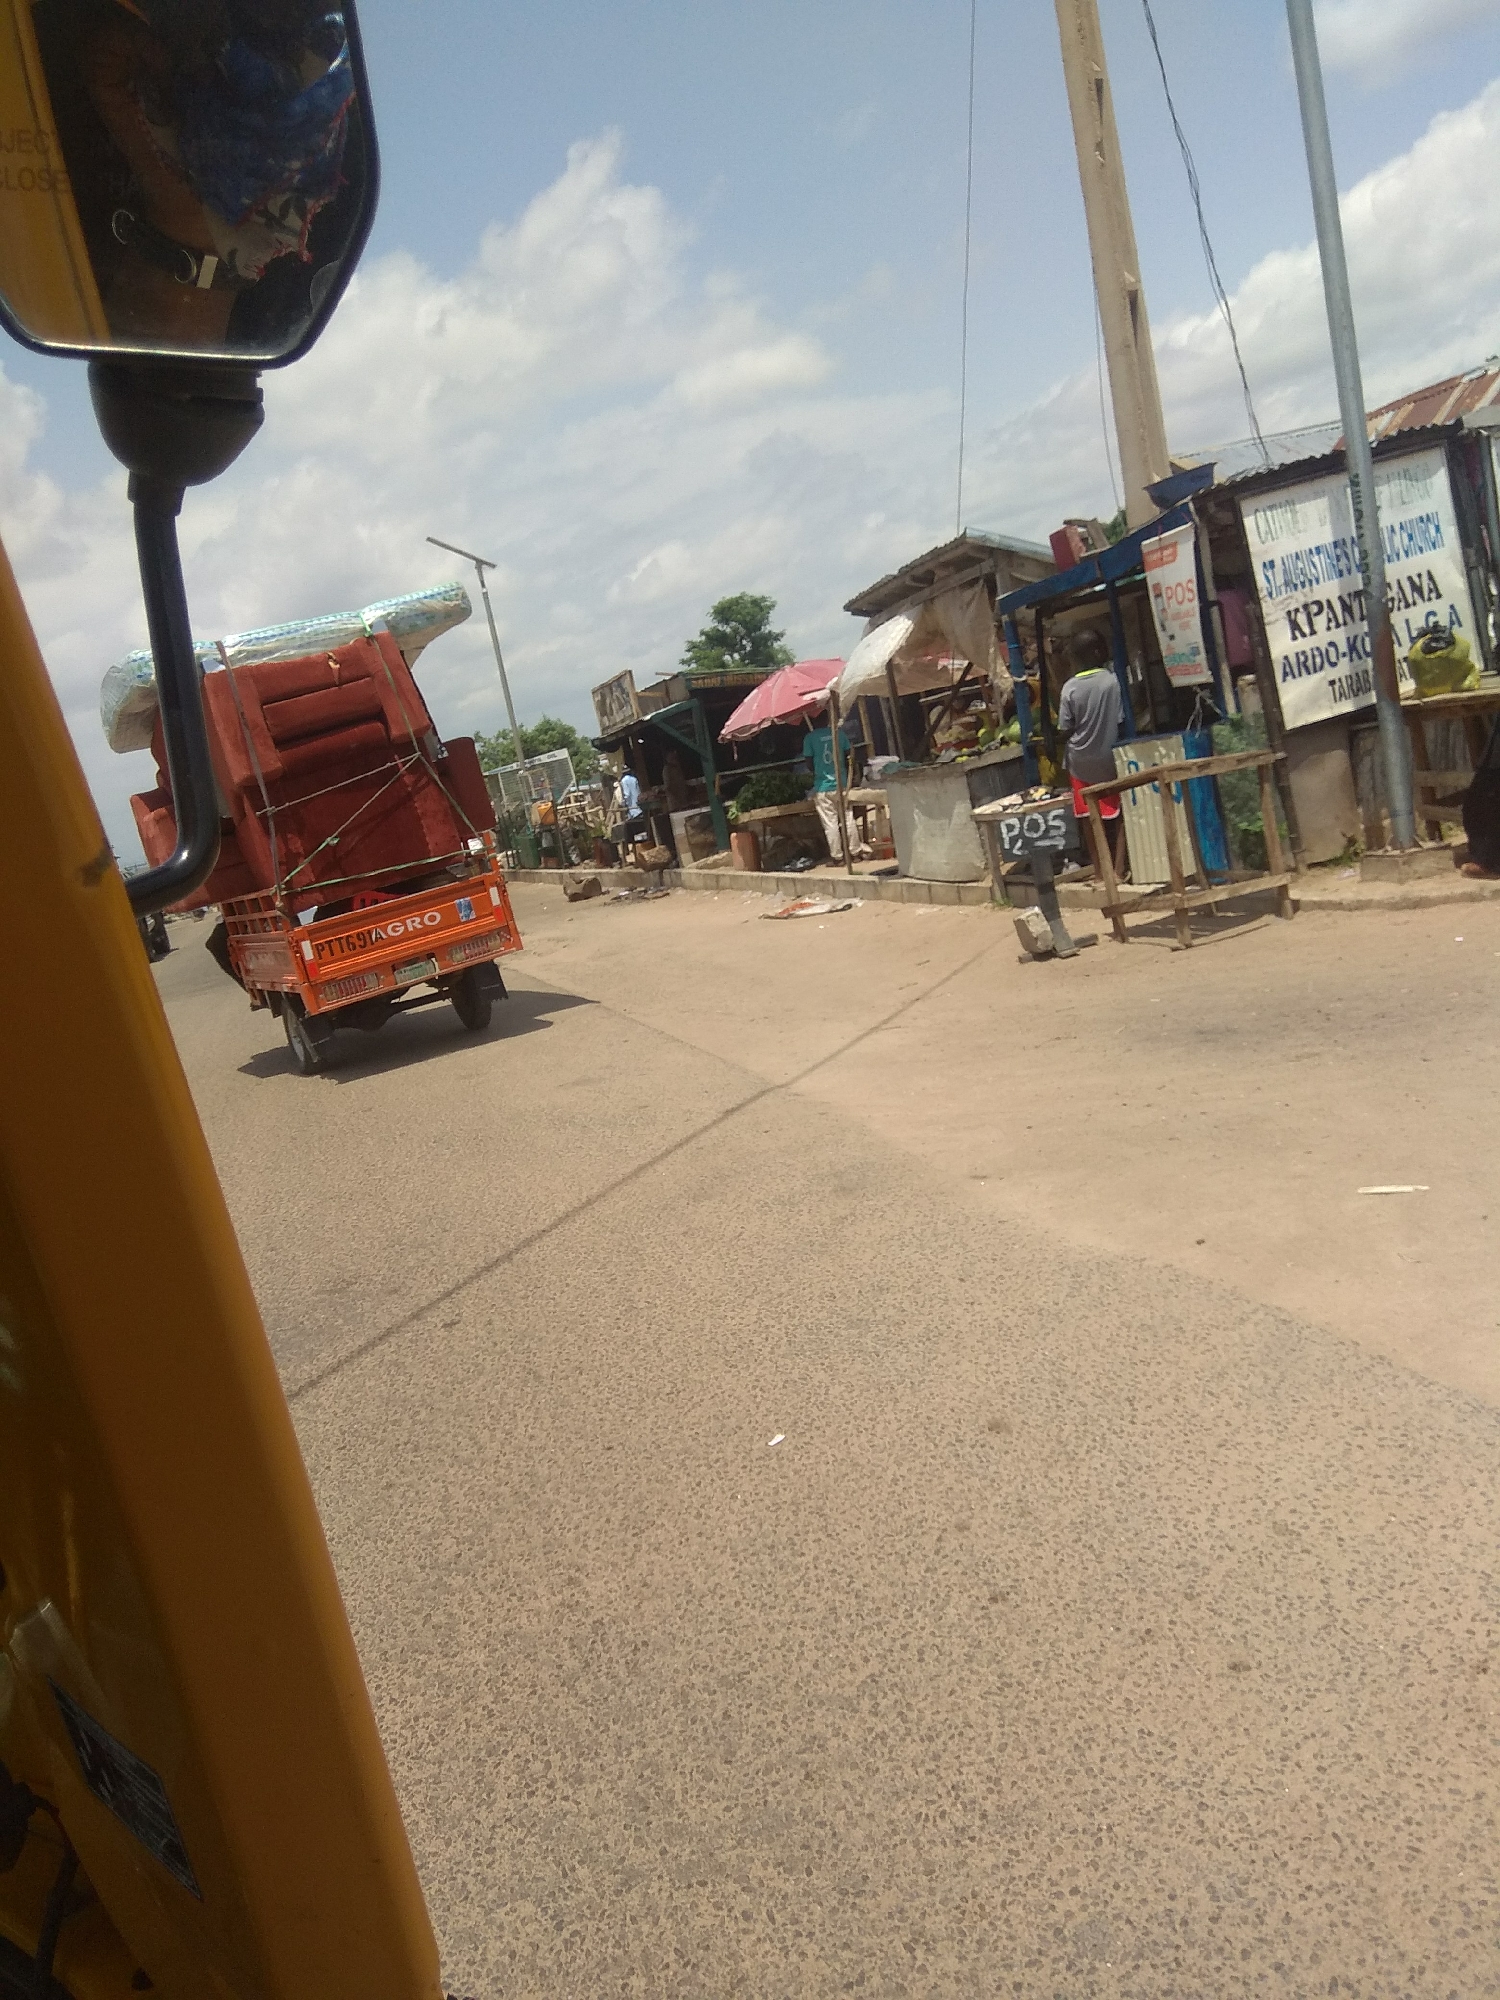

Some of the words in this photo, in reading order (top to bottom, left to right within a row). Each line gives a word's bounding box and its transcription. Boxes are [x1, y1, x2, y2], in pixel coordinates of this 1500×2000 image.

[1399, 511, 1445, 559] CHURCH
[1165, 578, 1196, 609] POS
[1000, 808, 1067, 850] POS
[372, 911, 441, 943] AGRO
